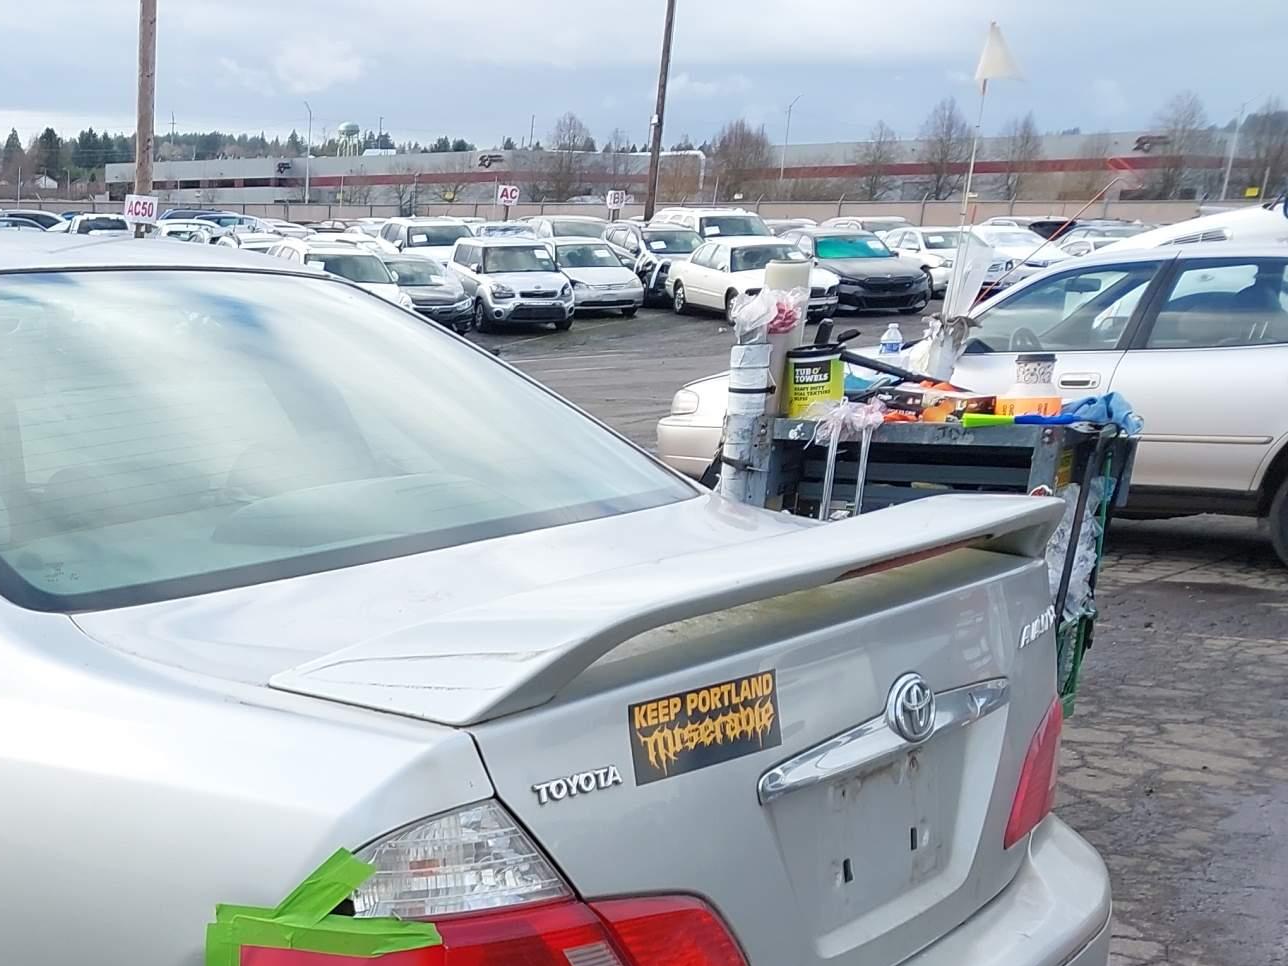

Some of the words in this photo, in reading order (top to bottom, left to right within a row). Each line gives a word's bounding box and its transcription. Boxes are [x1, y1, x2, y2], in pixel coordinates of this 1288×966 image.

[500, 187, 518, 200] AC
[127, 200, 154, 218] AC50
[795, 373, 829, 383] TOWELS
[634, 696, 682, 729] KEEP
[687, 674, 773, 716] PORTLAND
[532, 764, 623, 805] TOYOTA
